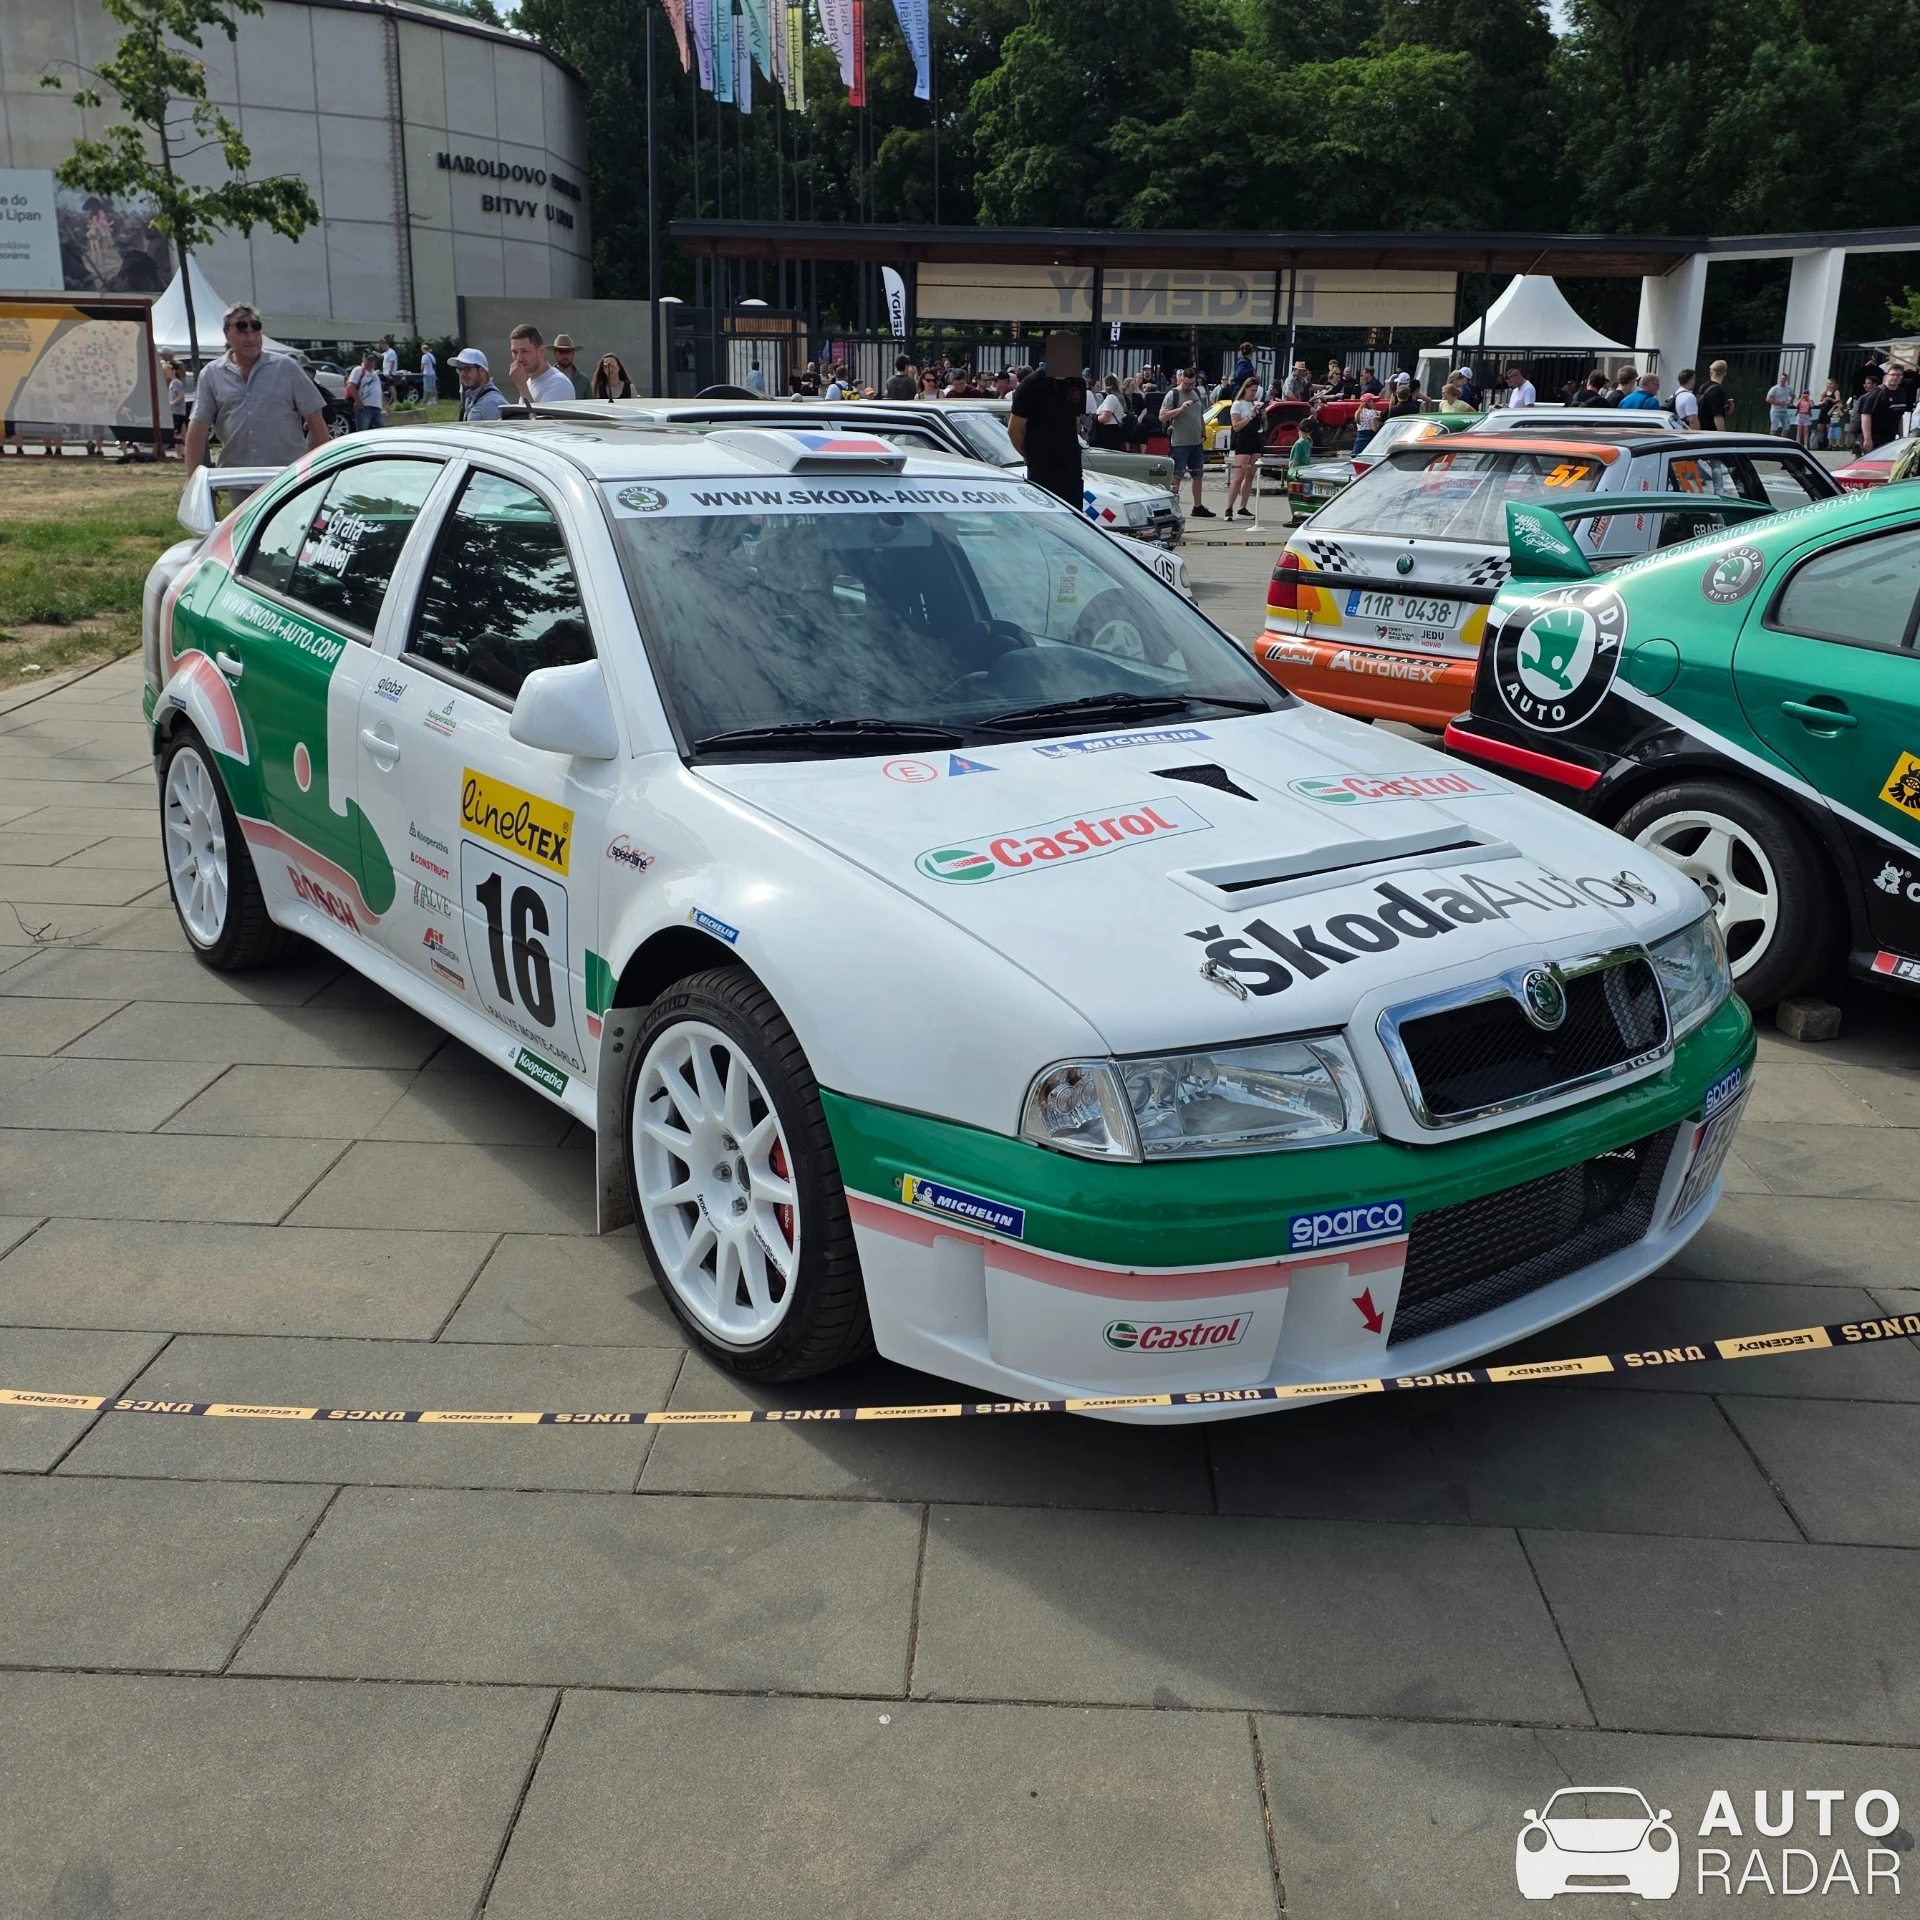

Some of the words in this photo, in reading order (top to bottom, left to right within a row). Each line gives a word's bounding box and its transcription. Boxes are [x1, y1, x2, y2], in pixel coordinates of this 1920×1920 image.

[437, 152, 547, 186] MAROLDOVO
[11, 194, 27, 206] do
[482, 194, 538, 218] BITVY
[6, 209, 41, 224] Lipan
[1543, 464, 1590, 487] 57
[690, 488, 1016, 508] WWW.SKODA-AUTO.COM
[1708, 589, 1738, 601] AUTO
[1347, 605, 1357, 613] CZ
[1363, 594, 1393, 618] 11R
[1404, 600, 1449, 624] 0438
[220, 591, 343, 664] WWW.SKODA-AUTO.COM
[1421, 630, 1445, 641] JEDU
[374, 677, 408, 698] global
[1506, 682, 1566, 721] AUTO
[1084, 729, 1198, 752] MICHELIN
[1340, 773, 1482, 801] Castrol
[989, 805, 1179, 868] Castrol
[414, 854, 449, 881] CONSTRUCT
[287, 865, 363, 938] BOSCH
[696, 912, 737, 940] MICHELIN
[476, 870, 556, 1029] 16
[488, 1005, 519, 1033] RALLYE
[518, 1052, 564, 1091] Kooperativa
[1705, 1066, 1742, 1111] sparco
[936, 1195, 1014, 1228] MICHELIN
[1291, 1202, 1403, 1247] sparco
[1139, 1318, 1241, 1350] Castrol
[1737, 1334, 1815, 1352] LEGENDY
[1623, 1346, 1706, 1367] UNCS
[1396, 1371, 1476, 1388] UNCS
[113, 1399, 194, 1413] UNCS
[975, 1401, 1051, 1413] UNCS
[1185, 1390, 1262, 1403] UNCS
[328, 1409, 405, 1421] UNCS
[554, 1413, 631, 1423] UNCS
[765, 1409, 841, 1420] UNCS
